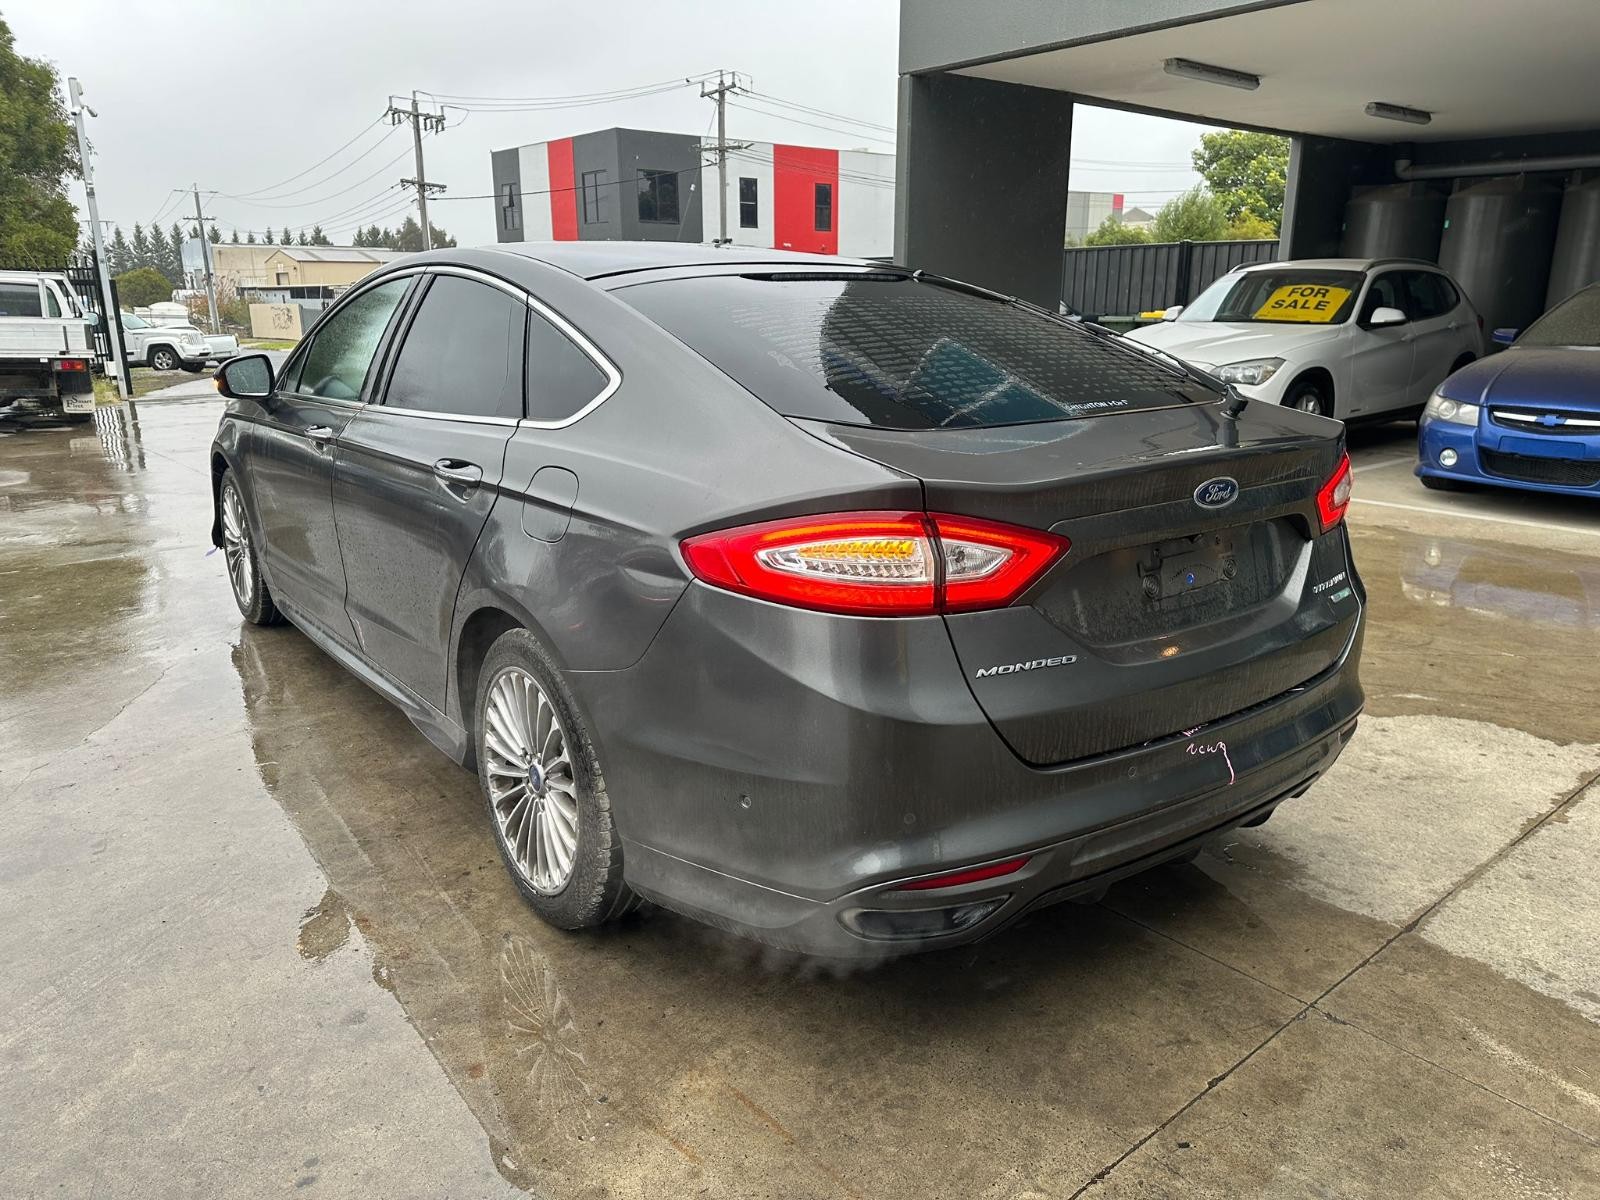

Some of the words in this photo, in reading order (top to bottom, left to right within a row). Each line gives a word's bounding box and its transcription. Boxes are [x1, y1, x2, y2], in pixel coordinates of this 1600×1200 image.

[1287, 287, 1330, 298] FOR
[1271, 299, 1331, 311] SALE
[976, 655, 1078, 678] MONDEO
